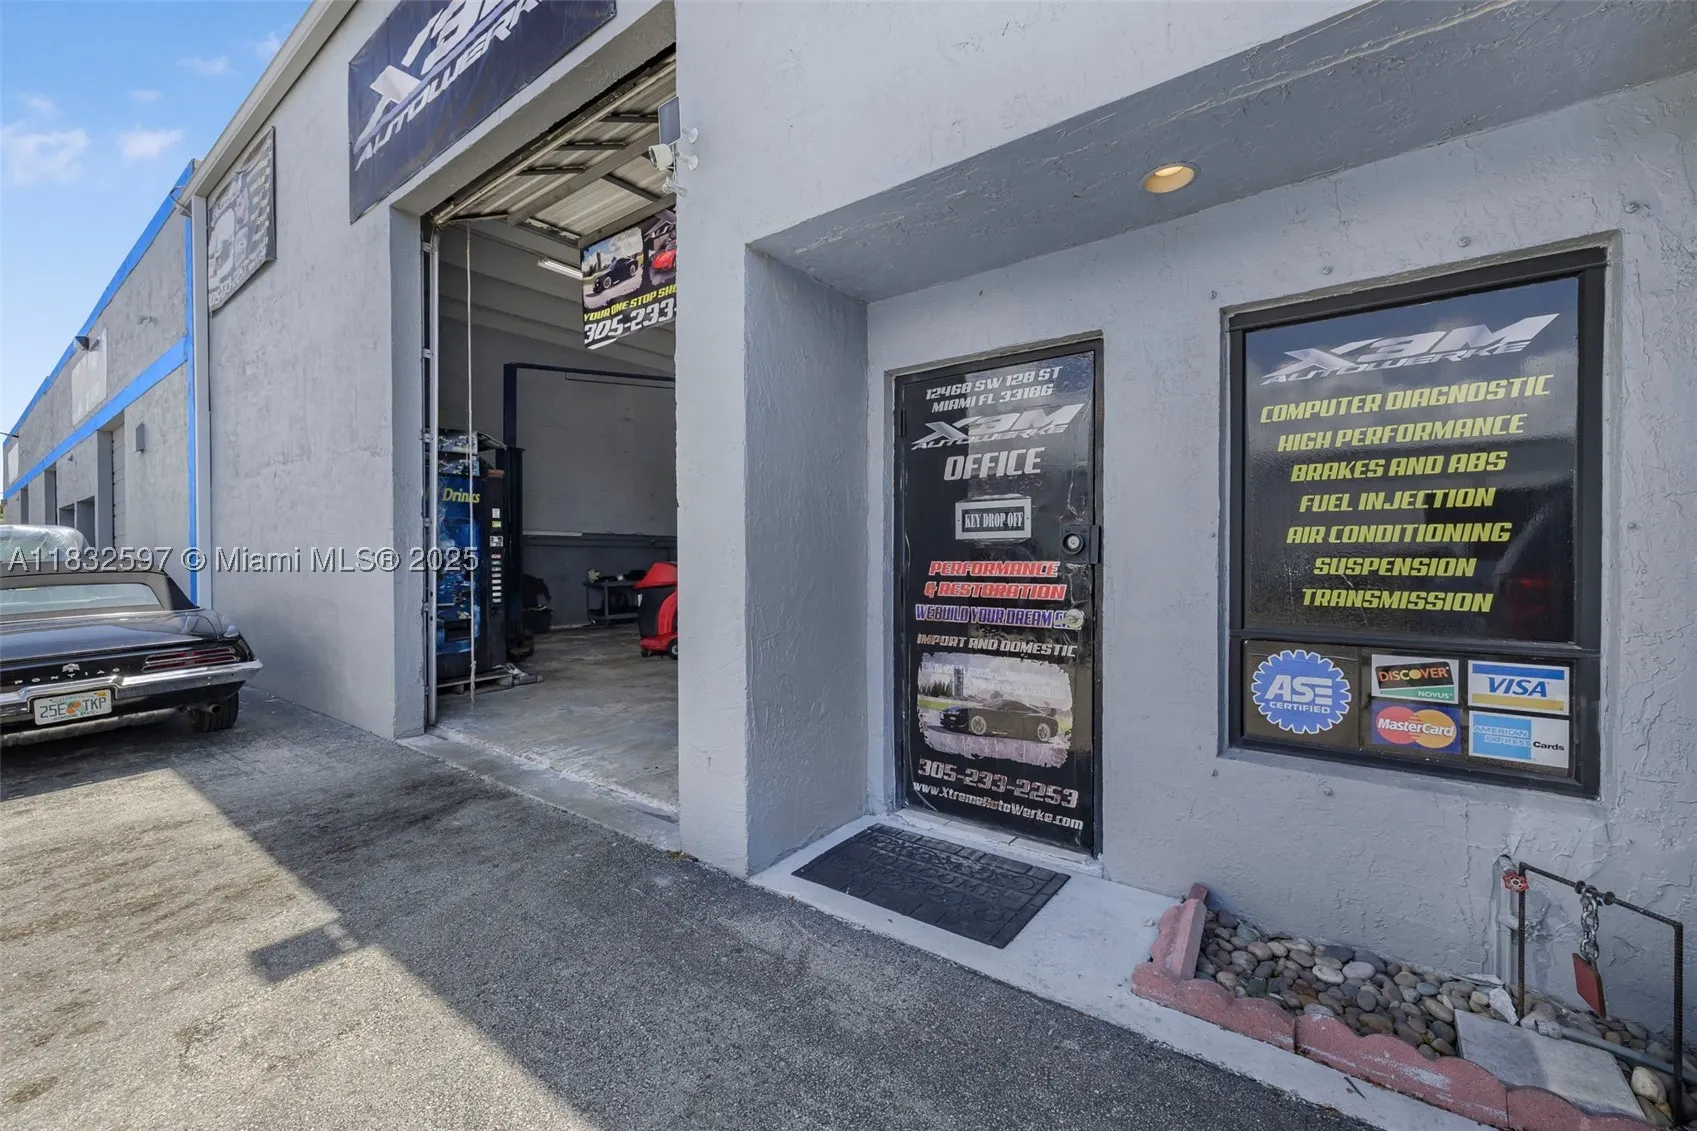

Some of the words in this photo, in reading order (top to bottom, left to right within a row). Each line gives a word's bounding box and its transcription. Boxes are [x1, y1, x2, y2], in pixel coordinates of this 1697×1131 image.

[584, 307, 611, 322] YOUR
[611, 300, 630, 315] ONE
[630, 292, 658, 308] STOP
[926, 382, 973, 400] 12468
[974, 378, 1002, 394] SW
[1005, 370, 1034, 386] 128
[1037, 366, 1063, 381] ST
[932, 397, 977, 413] MIAMI
[978, 393, 996, 405] FL
[999, 383, 1054, 403] 33186
[1260, 393, 1381, 423] COMPUTER
[1385, 374, 1554, 411] DIAGNOSTIC
[1277, 430, 1333, 453] HIGH
[1334, 413, 1528, 448] PERFORMANCE
[943, 447, 1046, 482] OFFICE
[1290, 460, 1386, 482] BRAKES
[1388, 455, 1445, 477] AND
[1447, 451, 1509, 473] ABS
[1299, 494, 1354, 513] FUEL
[1357, 487, 1497, 511] INJECTION
[964, 513, 981, 528] KEY
[1286, 526, 1327, 544] AIR
[1328, 522, 1513, 544] CONDITIONING
[929, 560, 1060, 577] PERFORMANCE
[1313, 558, 1478, 578] SUSPENSION
[936, 582, 1068, 600] RESTORATION
[1302, 589, 1494, 613] TRANSMISSION
[915, 604, 935, 621] WE
[935, 605, 970, 624] BUILD
[970, 606, 1005, 626] YOUR
[1005, 609, 1053, 629] DREAM
[916, 632, 967, 649] IMPORT
[968, 637, 999, 652] AND
[999, 640, 1078, 658] DOMESTIC
[1378, 668, 1449, 682] DISCOVER
[1264, 675, 1332, 705] ASE
[1418, 690, 1450, 699] NOVUS
[1487, 676, 1547, 698] VISA
[82, 696, 107, 711] TKP
[1269, 701, 1331, 714] CERTIFIED
[1377, 717, 1456, 737] MasterCard
[1473, 724, 1529, 738] AMERICAN
[1484, 734, 1531, 748] EXPRESS
[1533, 740, 1565, 751] Cards
[917, 758, 1079, 808] 305-233-2253
[913, 782, 1084, 831] www.XtremeAutoWerke.com
